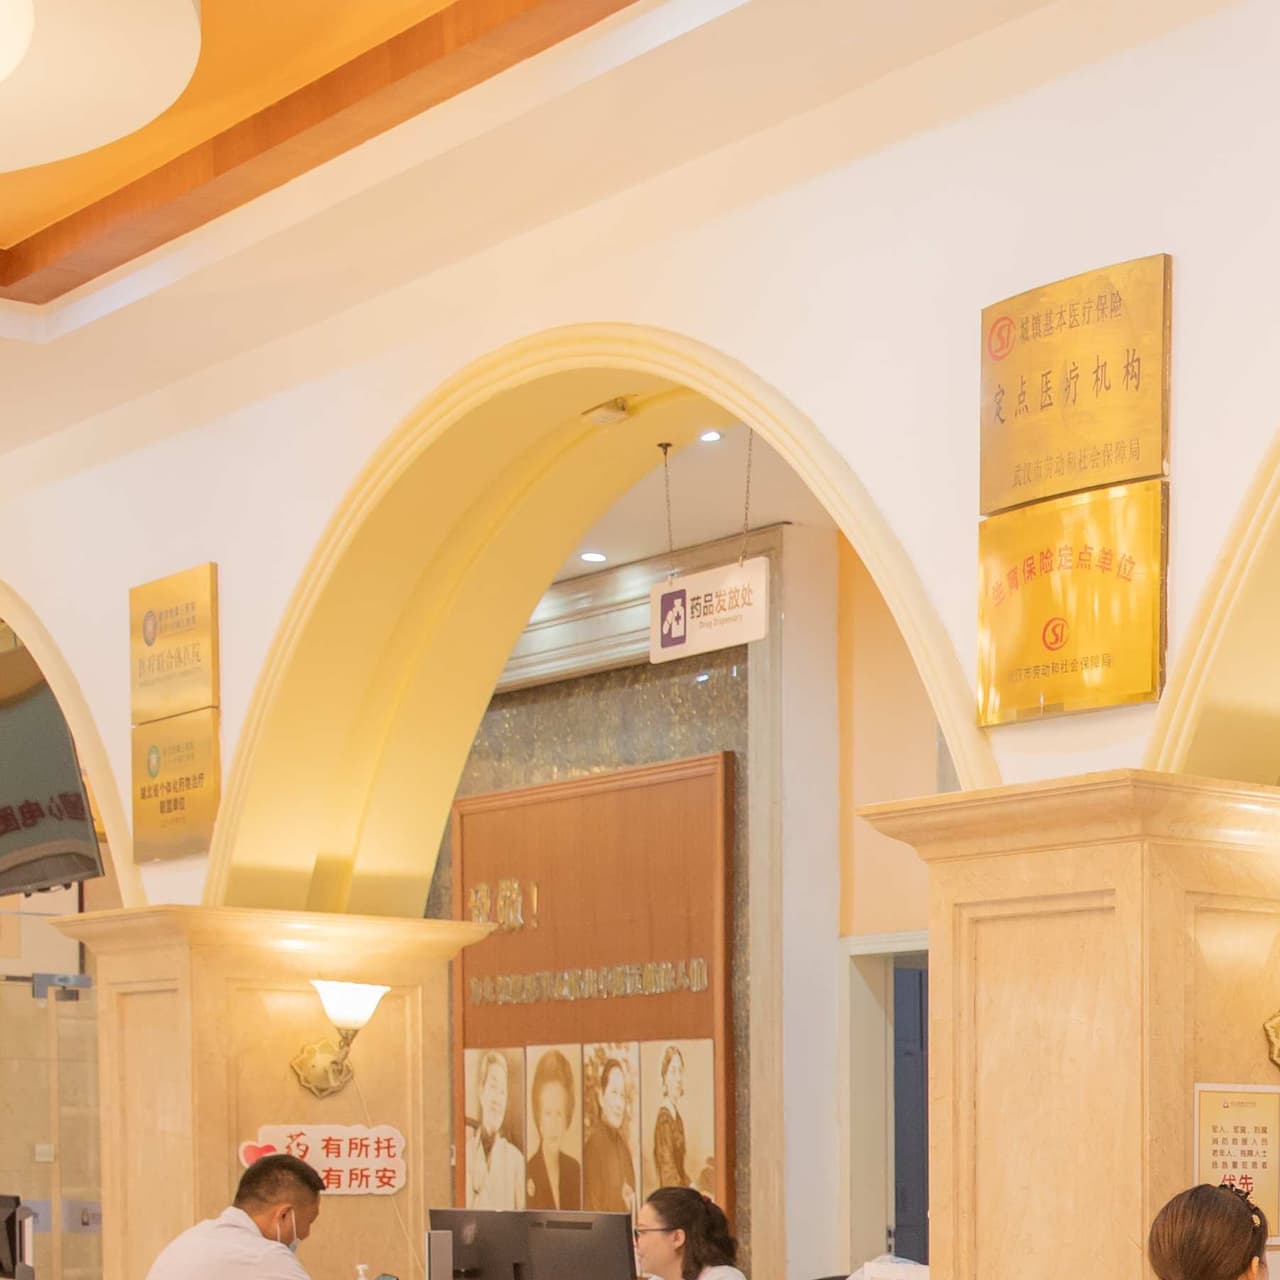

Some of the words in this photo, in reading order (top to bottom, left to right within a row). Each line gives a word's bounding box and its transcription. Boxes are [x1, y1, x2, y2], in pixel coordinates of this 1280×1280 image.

[993, 348, 1142, 424] 定点医疗机构
[690, 583, 753, 620] 药品发放处
[321, 1135, 397, 1159] 有所托
[322, 1167, 397, 1189] 有所安
